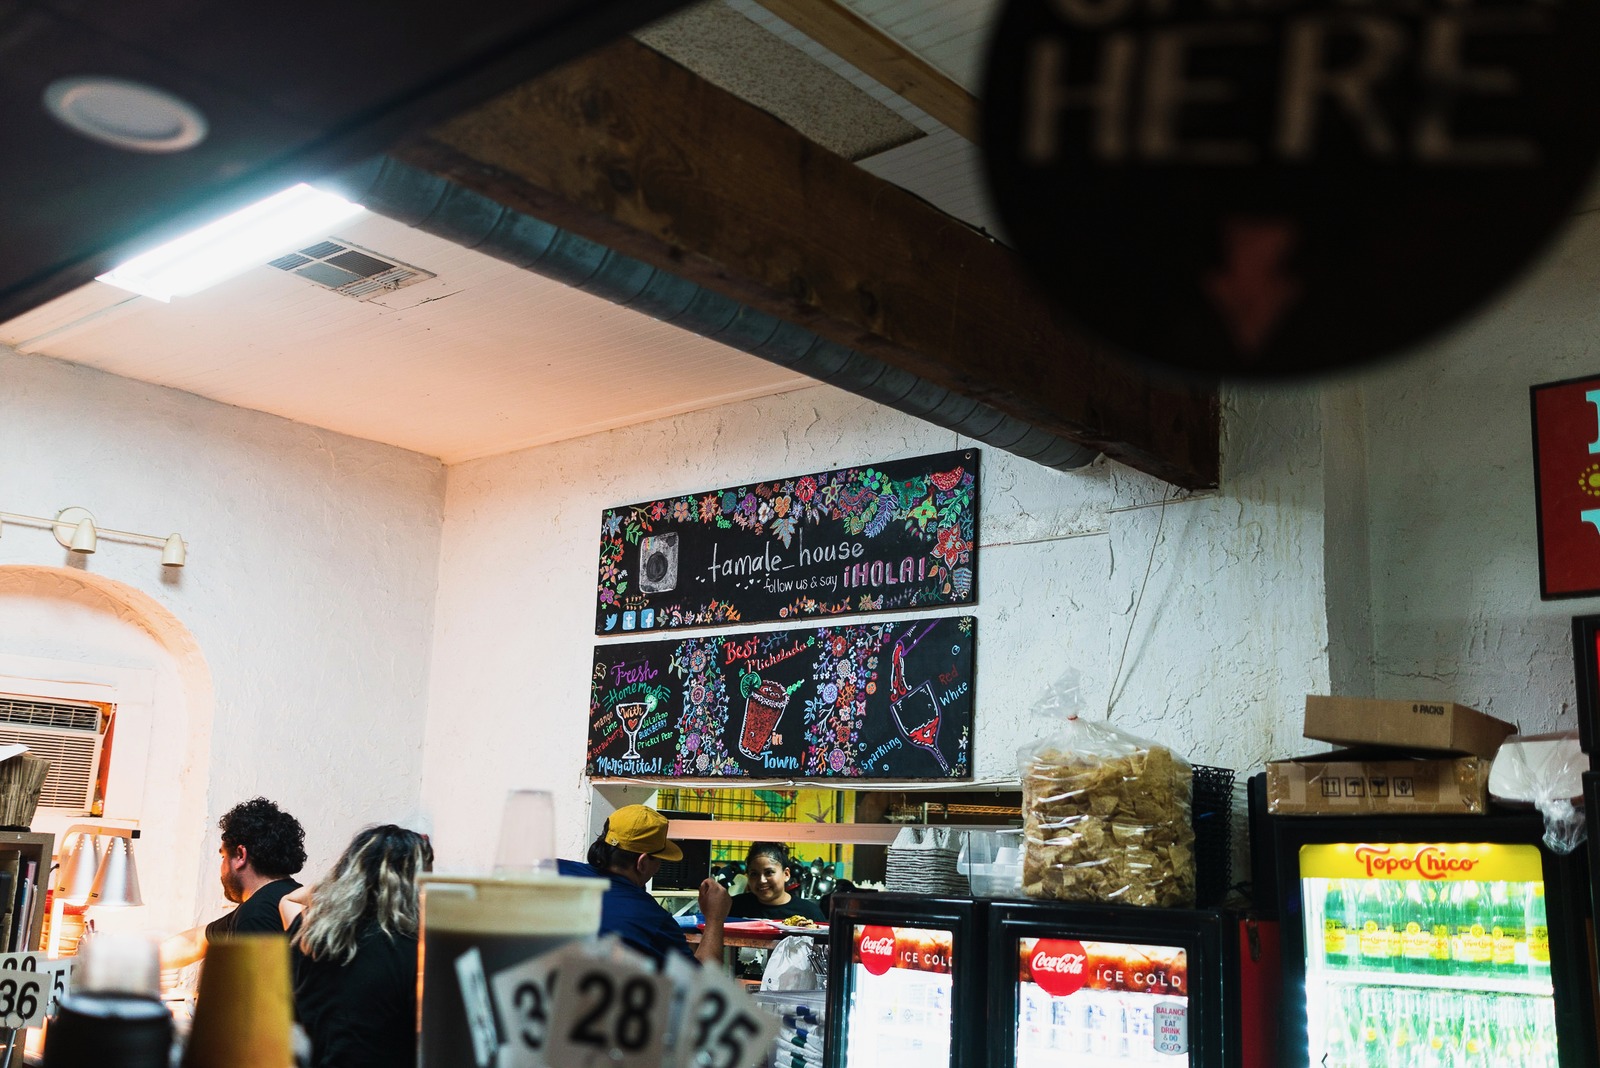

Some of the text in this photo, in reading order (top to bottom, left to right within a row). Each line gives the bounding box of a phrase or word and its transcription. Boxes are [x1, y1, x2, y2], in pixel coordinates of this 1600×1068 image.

[1020, 12, 1556, 165] HERE
[763, 578, 793, 593] follow
[795, 578, 809, 590] us
[810, 575, 818, 588] &
[819, 575, 838, 593] say
[610, 660, 658, 686] Fresh
[938, 664, 959, 685] Red
[939, 681, 968, 707] White
[1412, 704, 1444, 716] 6 PACKS
[900, 951, 919, 963] ICE
[1096, 969, 1182, 988] ICE COLD
[0, 978, 40, 1020] 36
[568, 969, 656, 1052] 28
[1156, 1007, 1185, 1016] BALANCE
[1161, 1026, 1181, 1035] DRINK
